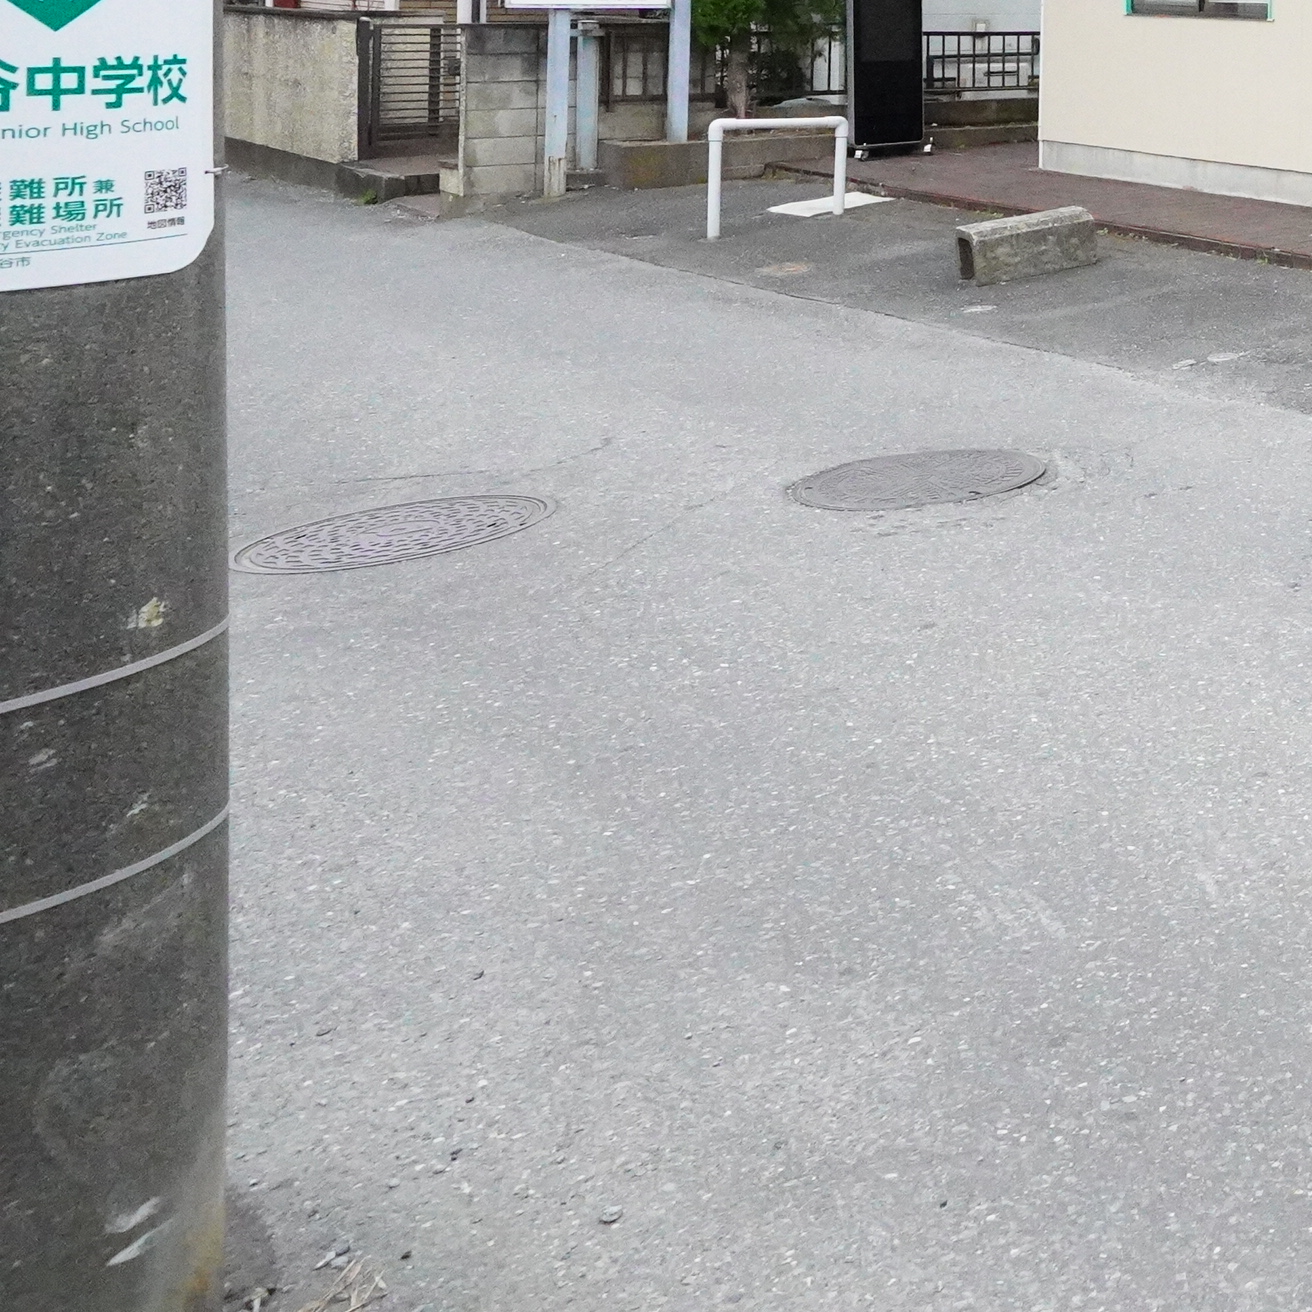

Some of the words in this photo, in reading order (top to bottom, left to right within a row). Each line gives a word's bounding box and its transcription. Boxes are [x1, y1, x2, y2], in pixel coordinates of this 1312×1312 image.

[61, 120, 112, 140] High
[120, 116, 180, 134] School
[0, 175, 116, 201] 難所兼
[0, 196, 125, 226] 難場所
[50, 222, 98, 234] Shelter
[147, 215, 186, 230] 地図情報
[15, 235, 92, 249] Evacuation
[96, 231, 129, 242] Zone
